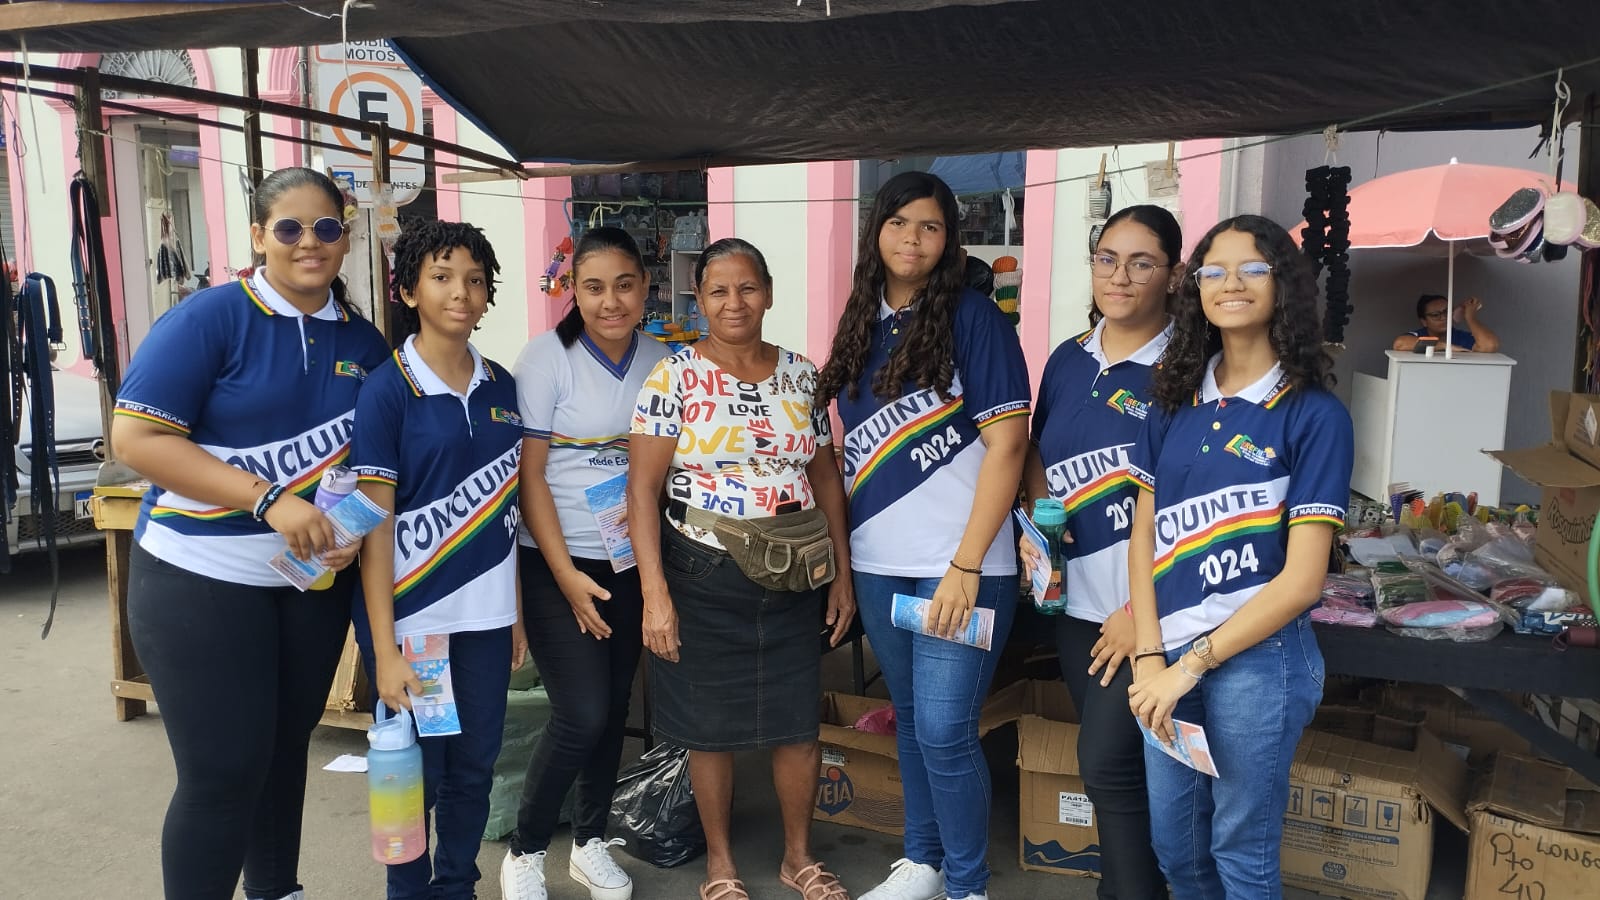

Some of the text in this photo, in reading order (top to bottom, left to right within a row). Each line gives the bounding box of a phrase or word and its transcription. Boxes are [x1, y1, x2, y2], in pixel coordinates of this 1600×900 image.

[346, 49, 396, 62] MOTOS
[728, 403, 773, 417] LOVE
[910, 425, 963, 473] 2024
[588, 457, 614, 467] Rede
[701, 492, 745, 516] LOVE
[1299, 506, 1338, 517] MARIANA
